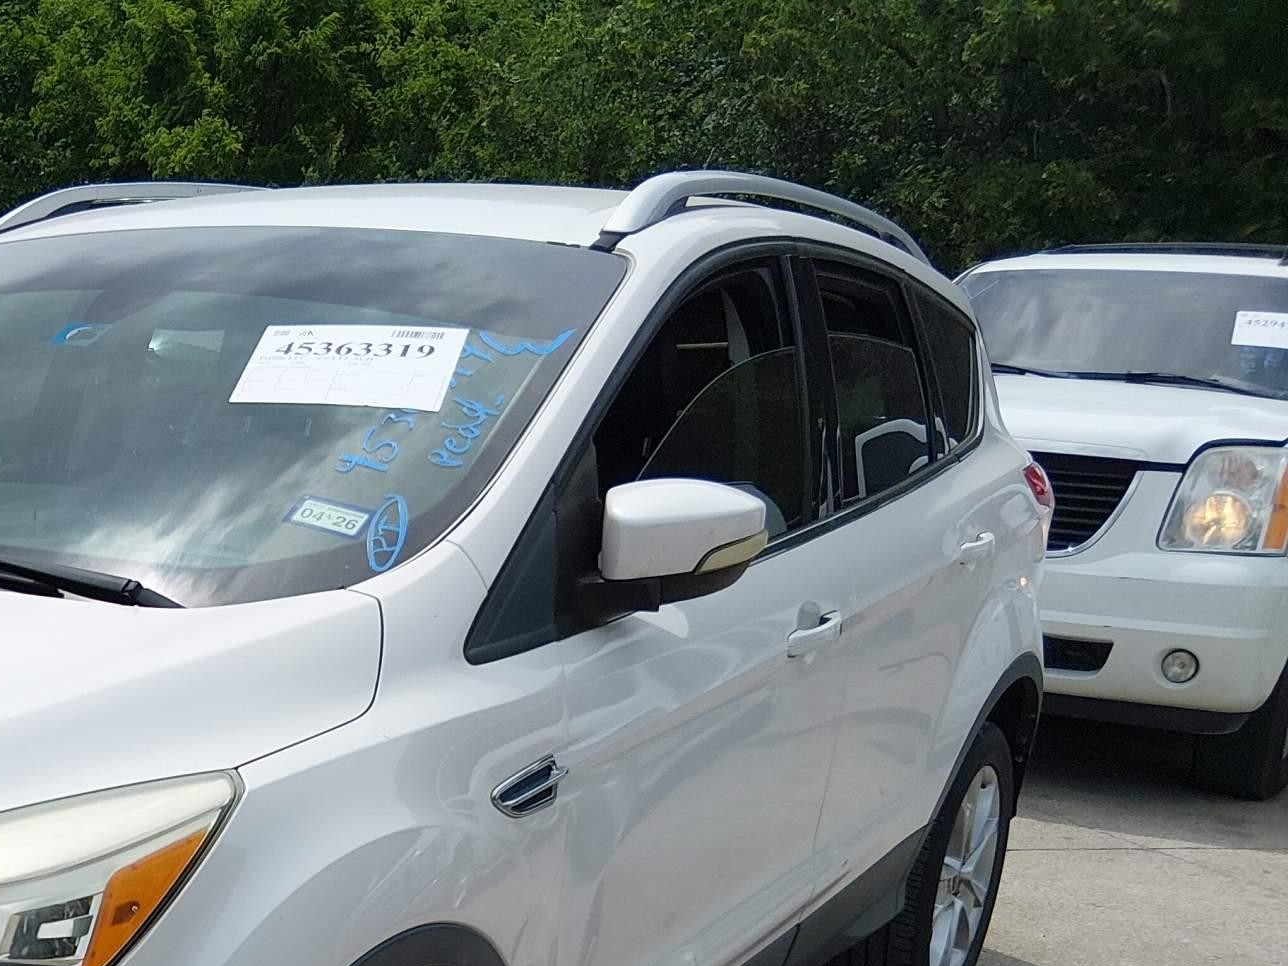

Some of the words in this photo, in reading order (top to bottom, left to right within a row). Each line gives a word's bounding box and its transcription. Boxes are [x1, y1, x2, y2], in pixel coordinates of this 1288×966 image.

[274, 341, 436, 359] 45363319
[300, 507, 325, 521] 04
[331, 515, 359, 530] 26
